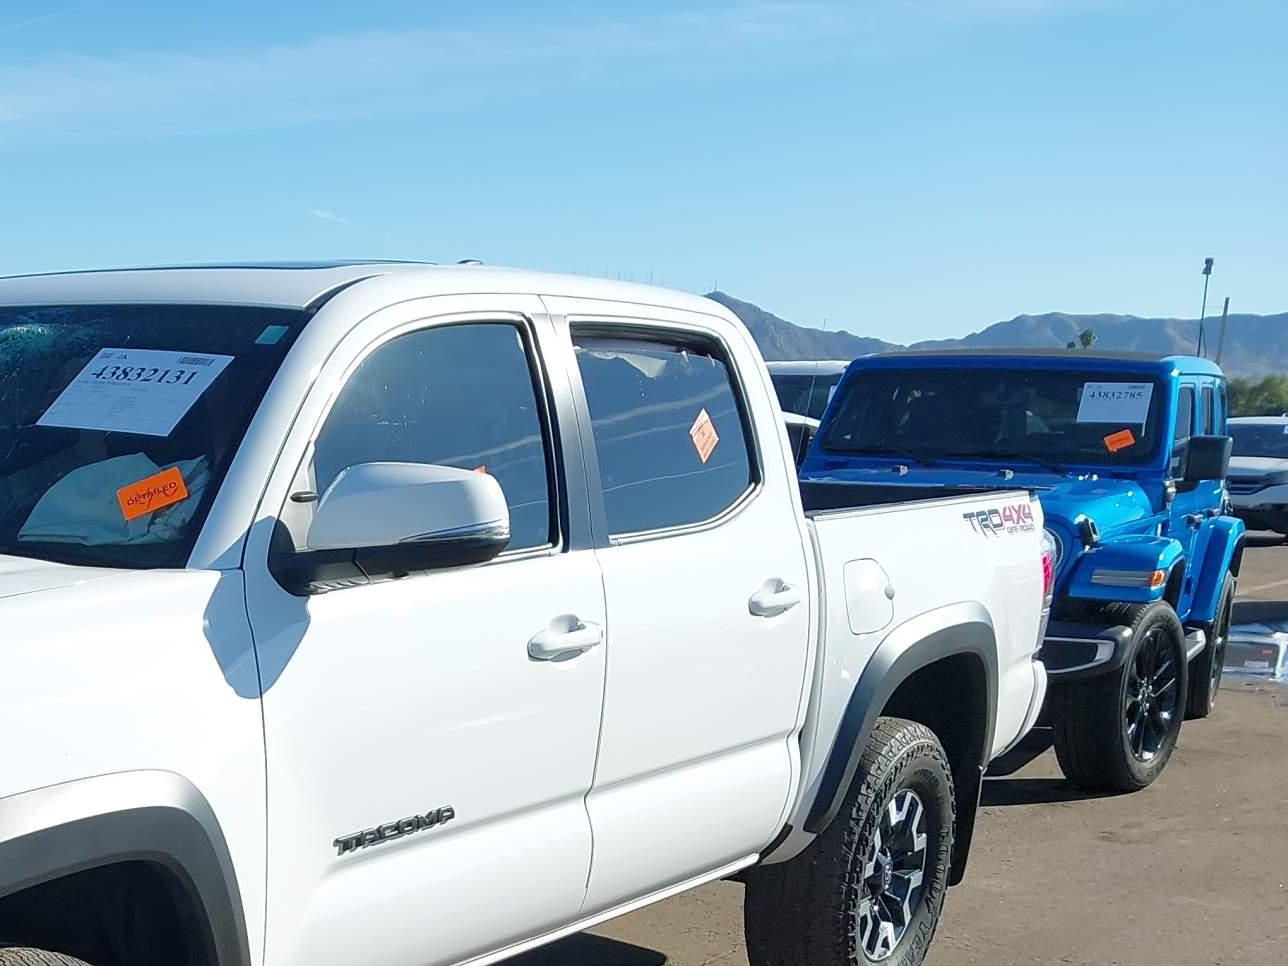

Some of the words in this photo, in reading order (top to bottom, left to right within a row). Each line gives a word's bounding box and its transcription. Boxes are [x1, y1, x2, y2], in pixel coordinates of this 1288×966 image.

[91, 364, 198, 385] 43832131
[1088, 391, 1143, 400] 43832785
[962, 508, 1004, 539] TRD
[333, 805, 456, 856] TACOMA
